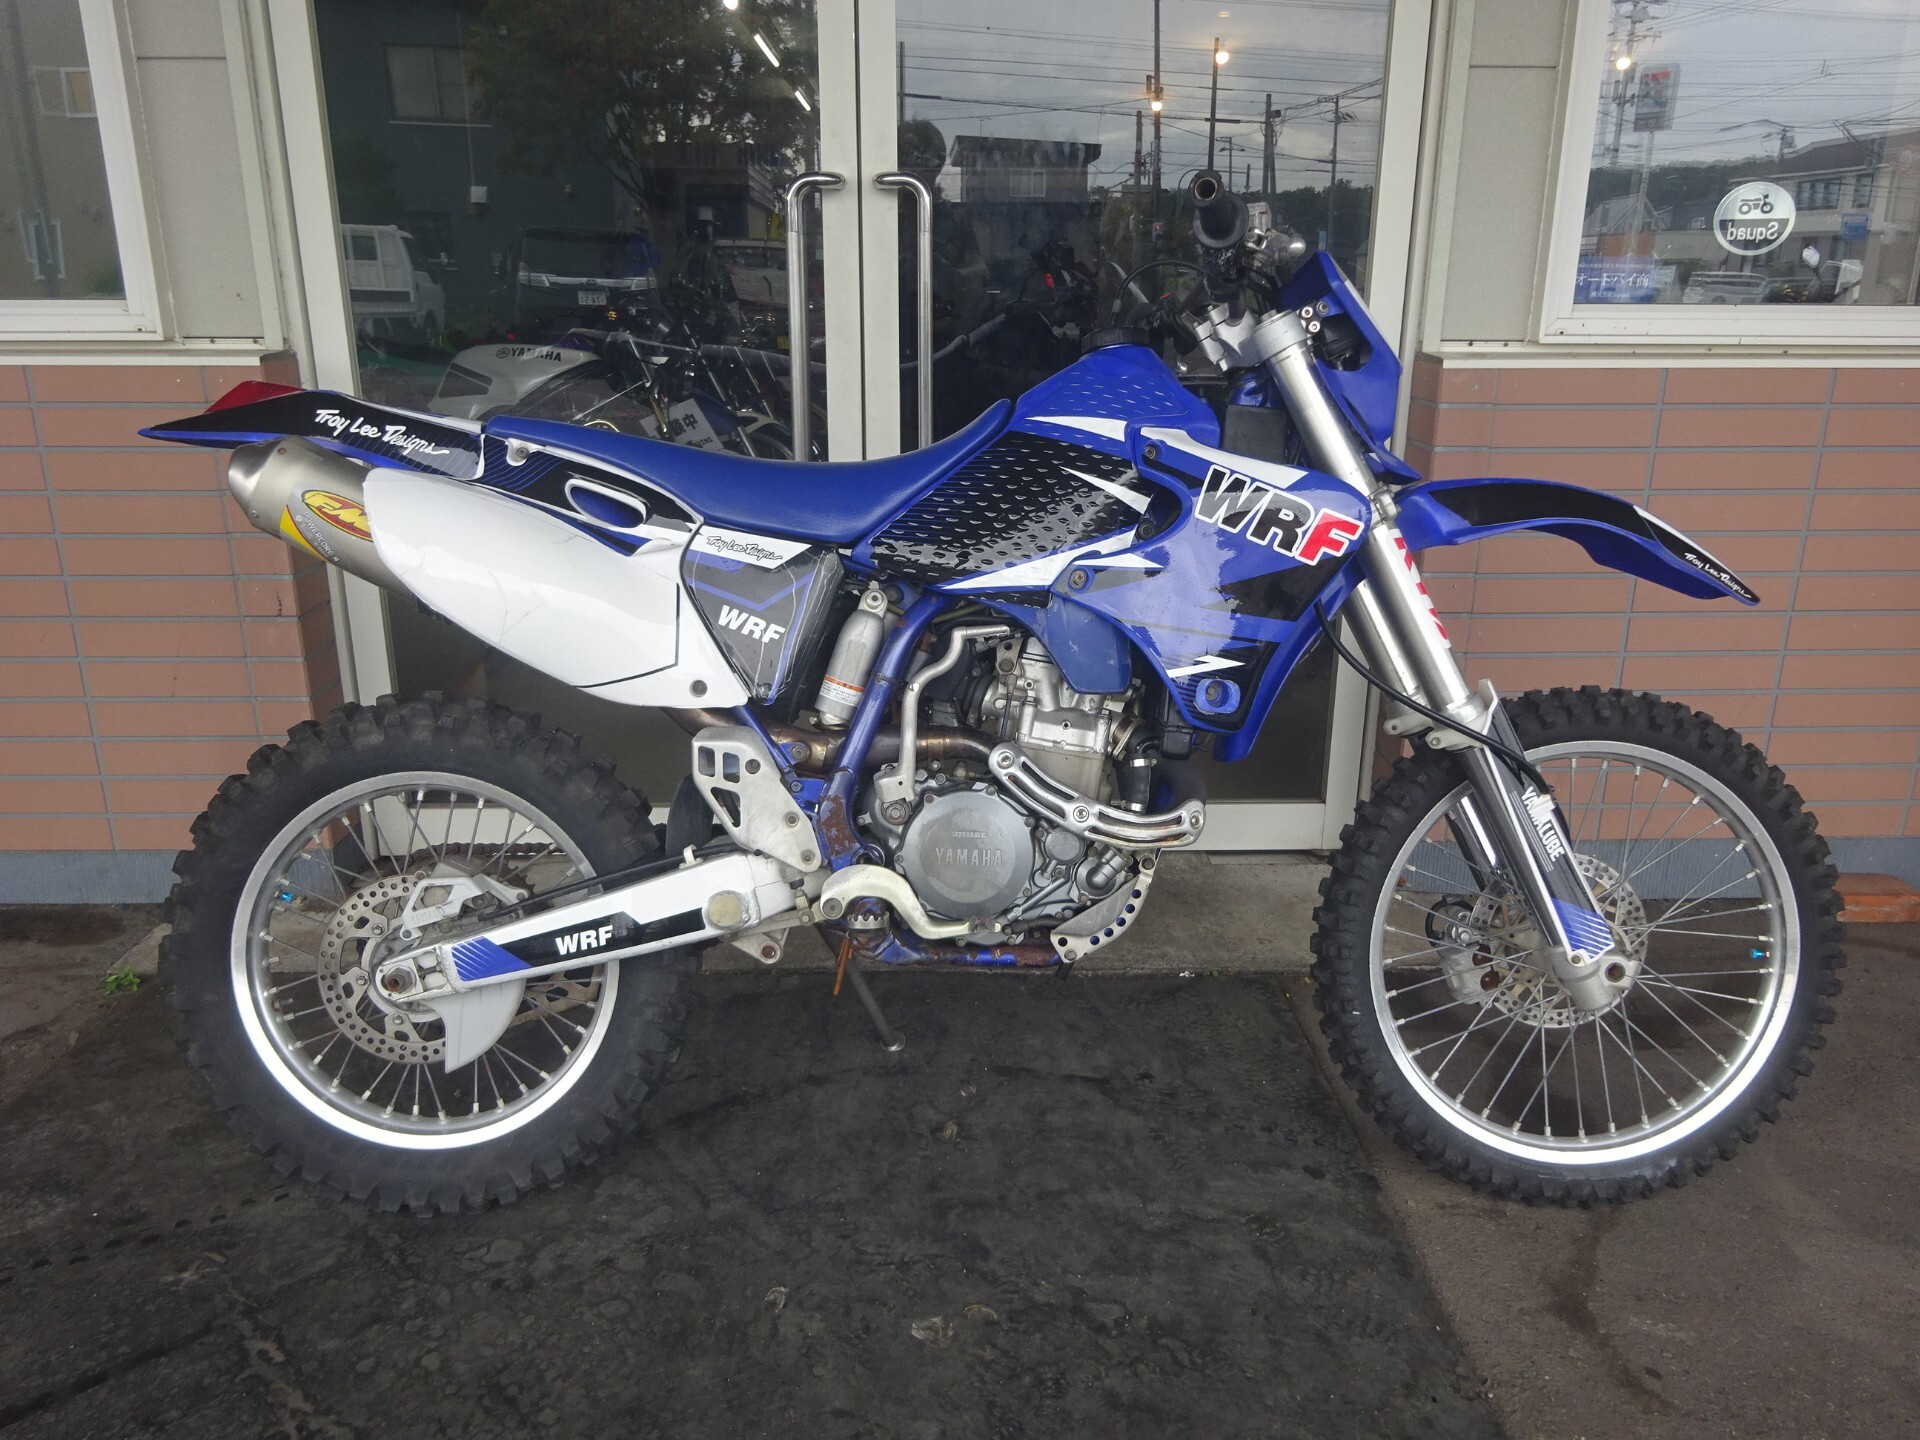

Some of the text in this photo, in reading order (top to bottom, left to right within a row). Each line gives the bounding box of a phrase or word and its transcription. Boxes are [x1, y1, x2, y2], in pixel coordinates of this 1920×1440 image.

[511, 347, 562, 361] YAHA
[315, 409, 450, 455] Troy Lee Designs
[303, 492, 373, 536] FM
[303, 511, 335, 556] POWERCORE
[1195, 464, 1365, 566] WRF
[707, 536, 784, 561] Troy Lee Designs
[1684, 552, 1752, 598] Troy Lee Designs
[718, 604, 786, 644] WRF
[935, 847, 1002, 867] YAMAHA
[554, 924, 613, 956] WRF
